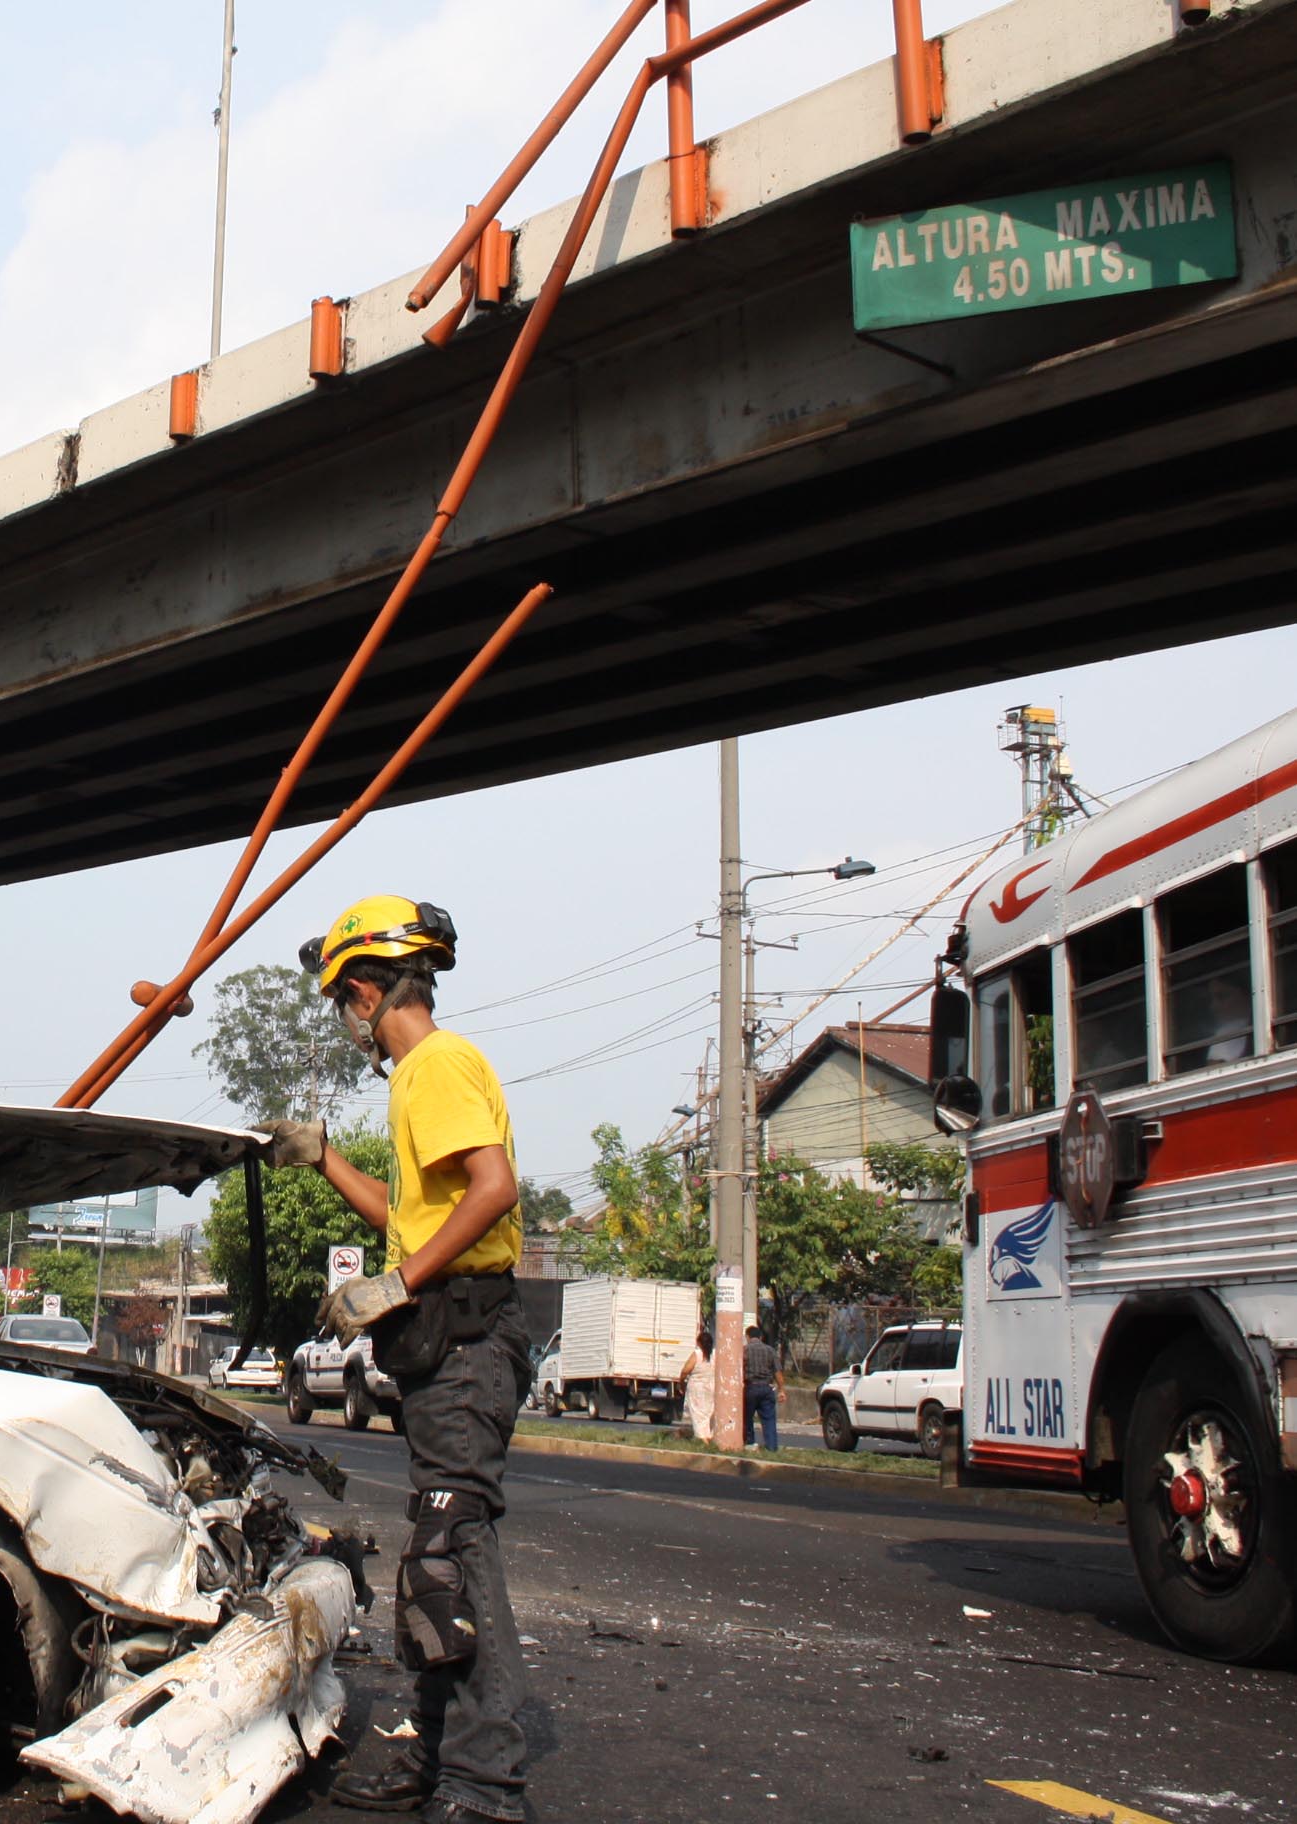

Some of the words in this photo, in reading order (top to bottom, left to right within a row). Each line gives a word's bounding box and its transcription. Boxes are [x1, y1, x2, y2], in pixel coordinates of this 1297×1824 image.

[872, 211, 1018, 271] ALTURA
[1056, 178, 1215, 242] MAXIMA
[952, 257, 1029, 304] 4.50
[1045, 241, 1135, 291] MTS.
[1066, 1133, 1106, 1184] STOP
[985, 1377, 1016, 1435] ALL
[1023, 1378, 1065, 1438] STAR
